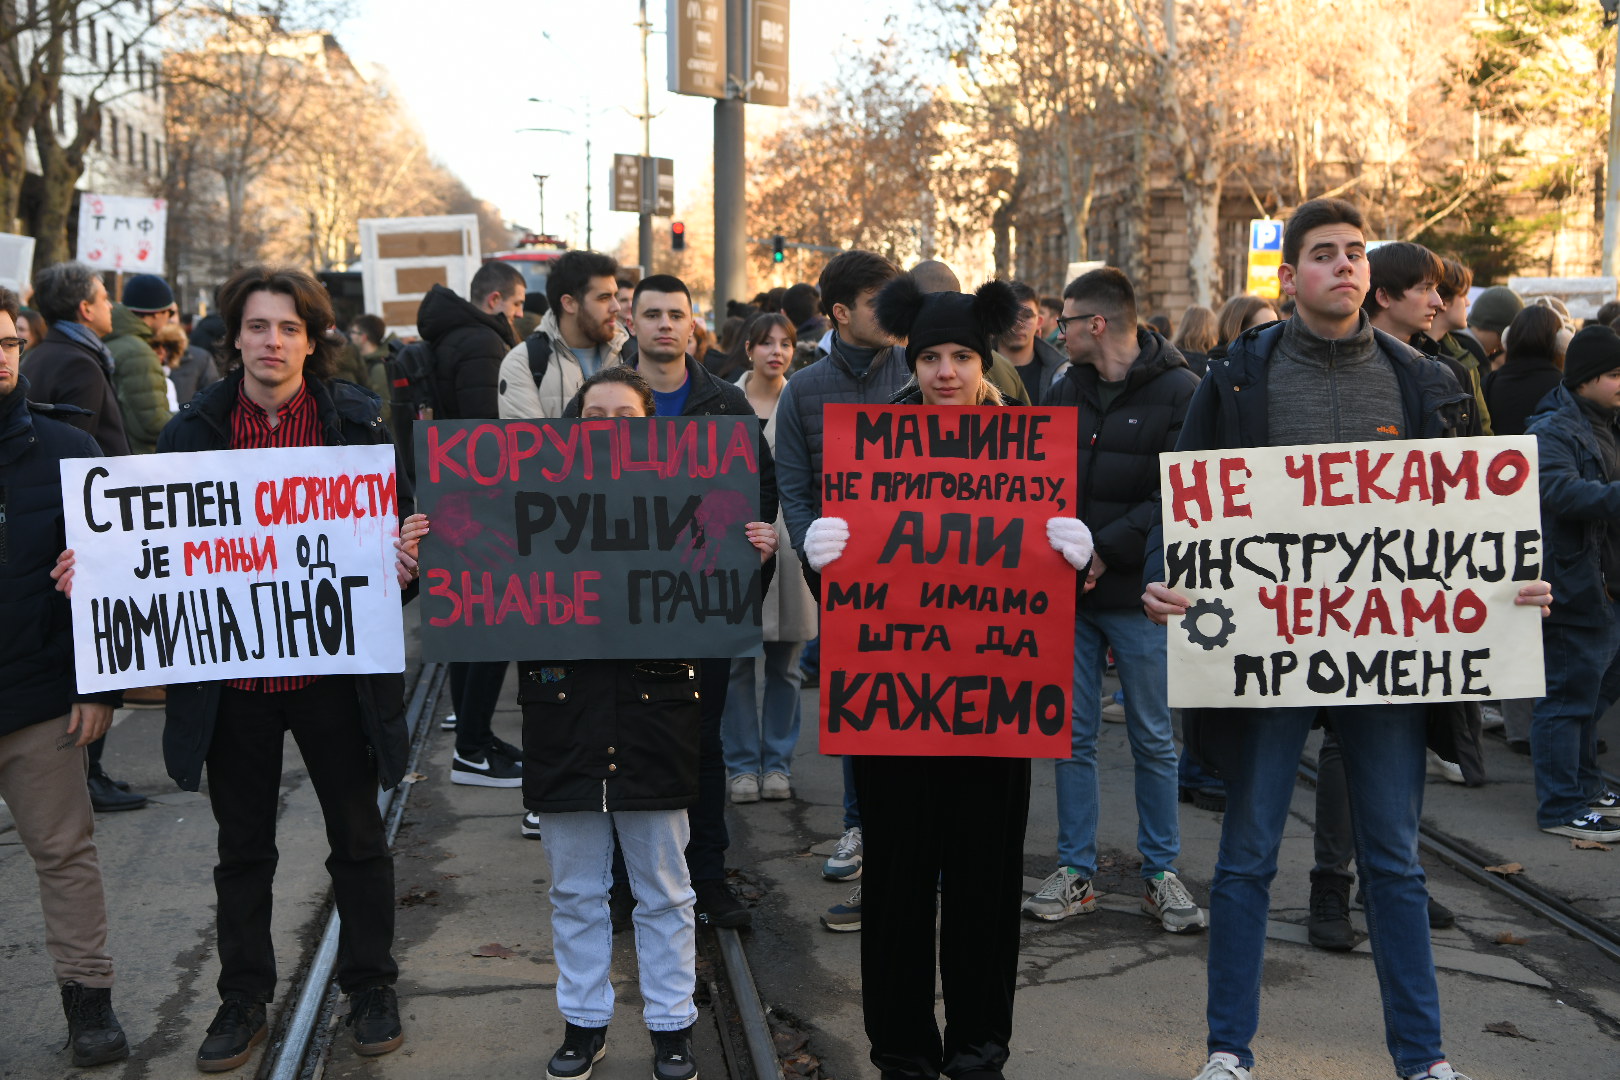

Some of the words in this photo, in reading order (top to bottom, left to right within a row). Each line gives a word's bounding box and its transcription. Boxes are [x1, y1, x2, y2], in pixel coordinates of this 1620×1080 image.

[1256, 224, 1277, 249] P
[428, 419, 758, 486] КОРУПЦИЈА
[855, 412, 1051, 461] МАШИНЕ
[824, 471, 862, 501] НЕ
[871, 471, 1067, 512] ПРИГОВАРАЈУ,
[1168, 458, 1253, 528] НЕ
[1285, 449, 1530, 507] ЧЕКАМО
[514, 491, 706, 556] РУШИ
[877, 511, 1024, 568] АЛИ
[183, 536, 278, 576] МАЊИ
[296, 534, 337, 580] ОД
[1166, 526, 1540, 590] ИНСТРУКЦИЈЕ
[91, 576, 368, 674] НОМИНАЛНОГ
[427, 568, 602, 627] ЗНАЊЕ
[628, 569, 763, 626] ГРАДИ
[826, 582, 889, 612] МИ
[920, 582, 1049, 614] ИМАМО
[1258, 585, 1487, 644] ЧЕКАМО
[858, 624, 951, 652] ШТА
[976, 626, 1039, 657] ДА
[1234, 648, 1491, 698] ПРОМЕНЕ
[827, 669, 1065, 736] КАЖЕМО
